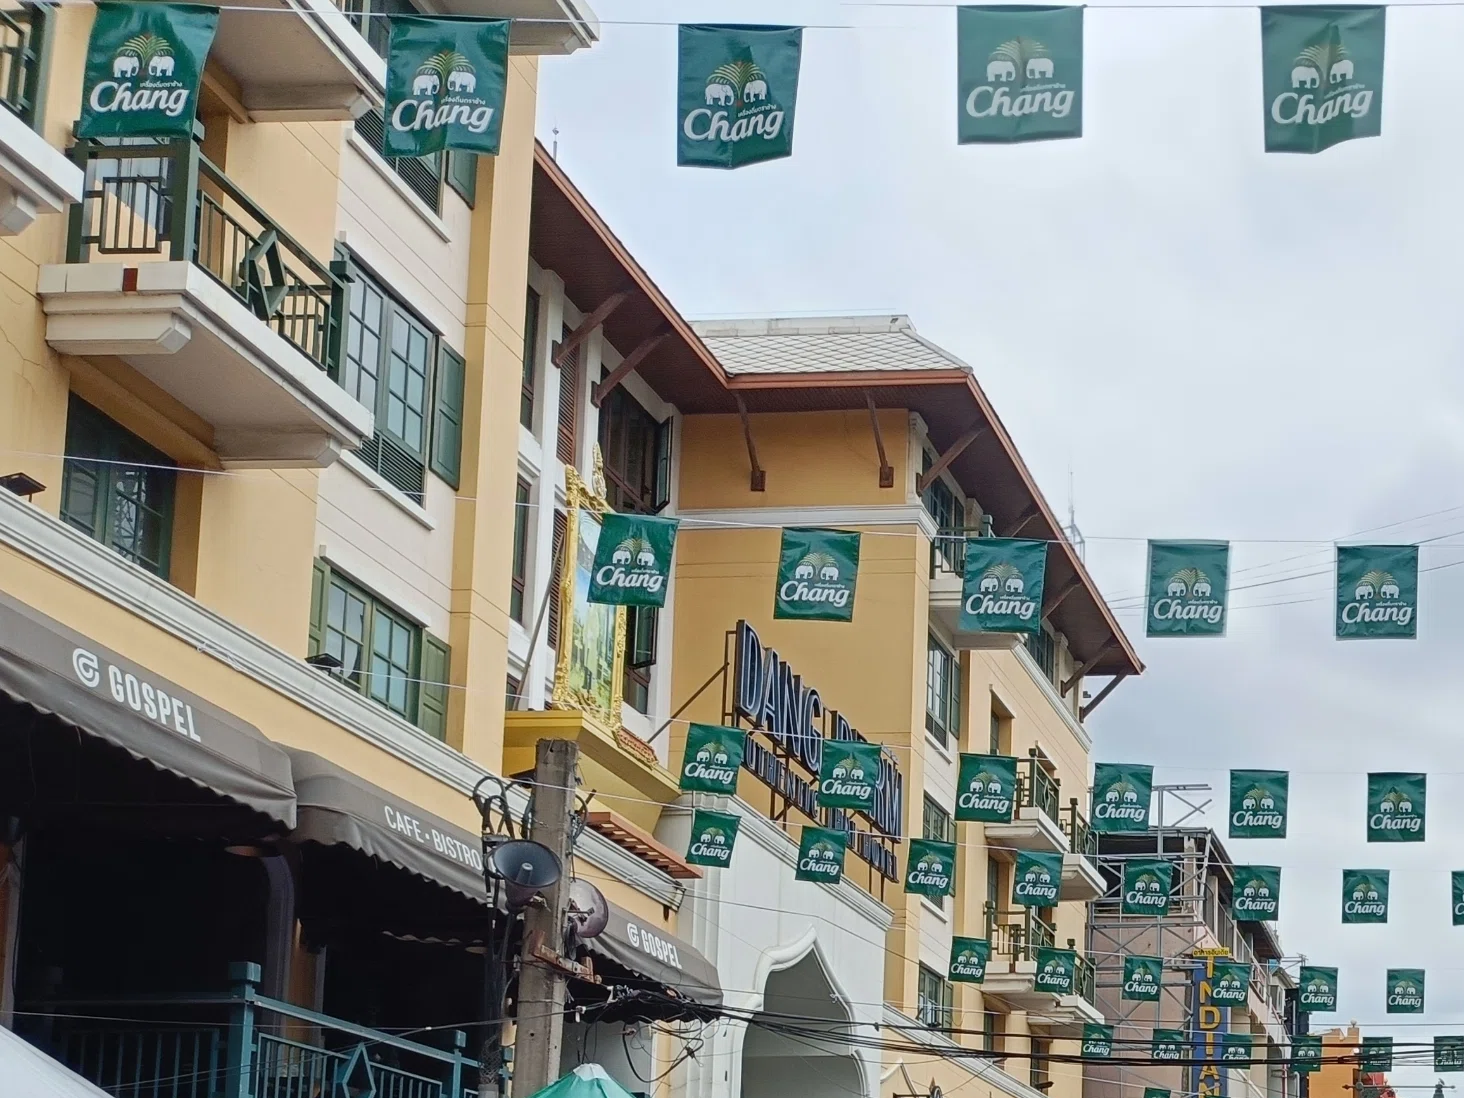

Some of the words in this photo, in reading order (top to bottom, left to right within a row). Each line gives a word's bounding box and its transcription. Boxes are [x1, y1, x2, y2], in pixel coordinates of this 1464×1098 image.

[90, 80, 189, 116] Chang
[966, 83, 1074, 117] Chang
[1272, 91, 1373, 124] Chang
[392, 96, 493, 132] Chang
[684, 109, 784, 141] Chang
[596, 566, 663, 592] Chang
[781, 581, 850, 607] Chang
[966, 594, 1035, 619] Chang
[1154, 599, 1222, 623] Chang
[1342, 602, 1412, 625] Chang
[108, 664, 201, 742] GOSPEL
[737, 619, 823, 773] DANG
[685, 763, 734, 784] Chang
[744, 734, 819, 819] UTHENTIC
[821, 779, 871, 799] Chang
[959, 791, 1010, 813] Chang
[1095, 804, 1145, 822] Chang
[1233, 811, 1282, 828] Chang
[1371, 814, 1421, 831] Chang
[384, 805, 424, 843] CAFE
[431, 829, 483, 871] BISTRO
[691, 843, 730, 860] Chang
[800, 859, 839, 875] Chang
[909, 871, 948, 888] Chang
[1016, 883, 1056, 898] Chang
[1126, 892, 1166, 907] Chang
[1235, 897, 1276, 912] Chang
[1345, 901, 1385, 915] Chang
[641, 929, 683, 970] GOSPEL
[951, 963, 982, 977] Chang
[1038, 974, 1069, 987] Chang
[1125, 982, 1157, 994] Chang
[1213, 988, 1245, 1001] Chang
[1301, 993, 1334, 1005] Chang
[1389, 995, 1421, 1007] Chang
